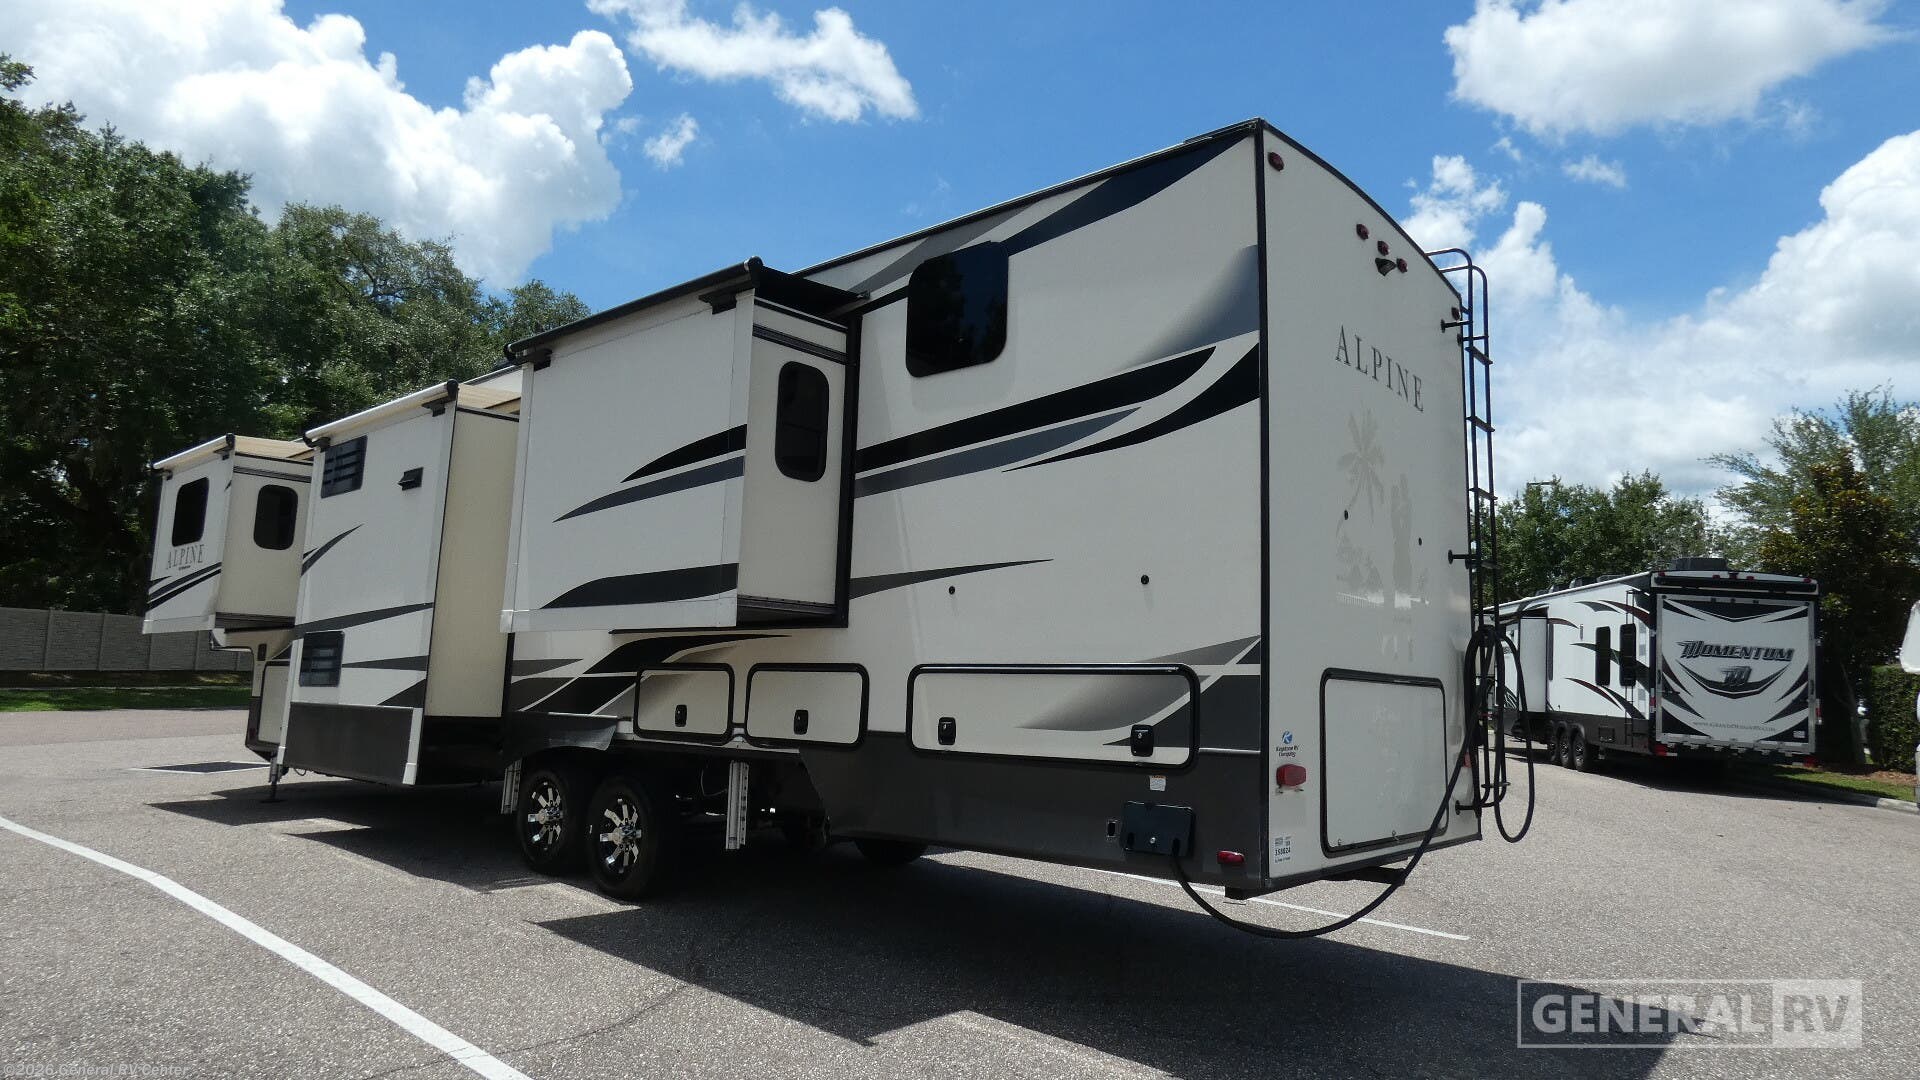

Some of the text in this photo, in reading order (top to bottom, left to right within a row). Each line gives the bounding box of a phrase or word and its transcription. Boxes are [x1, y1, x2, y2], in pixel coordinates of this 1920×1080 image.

[1335, 324, 1424, 412] ALPINE
[166, 544, 204, 569] ALPINE
[1676, 640, 1795, 661] MOMENTUM
